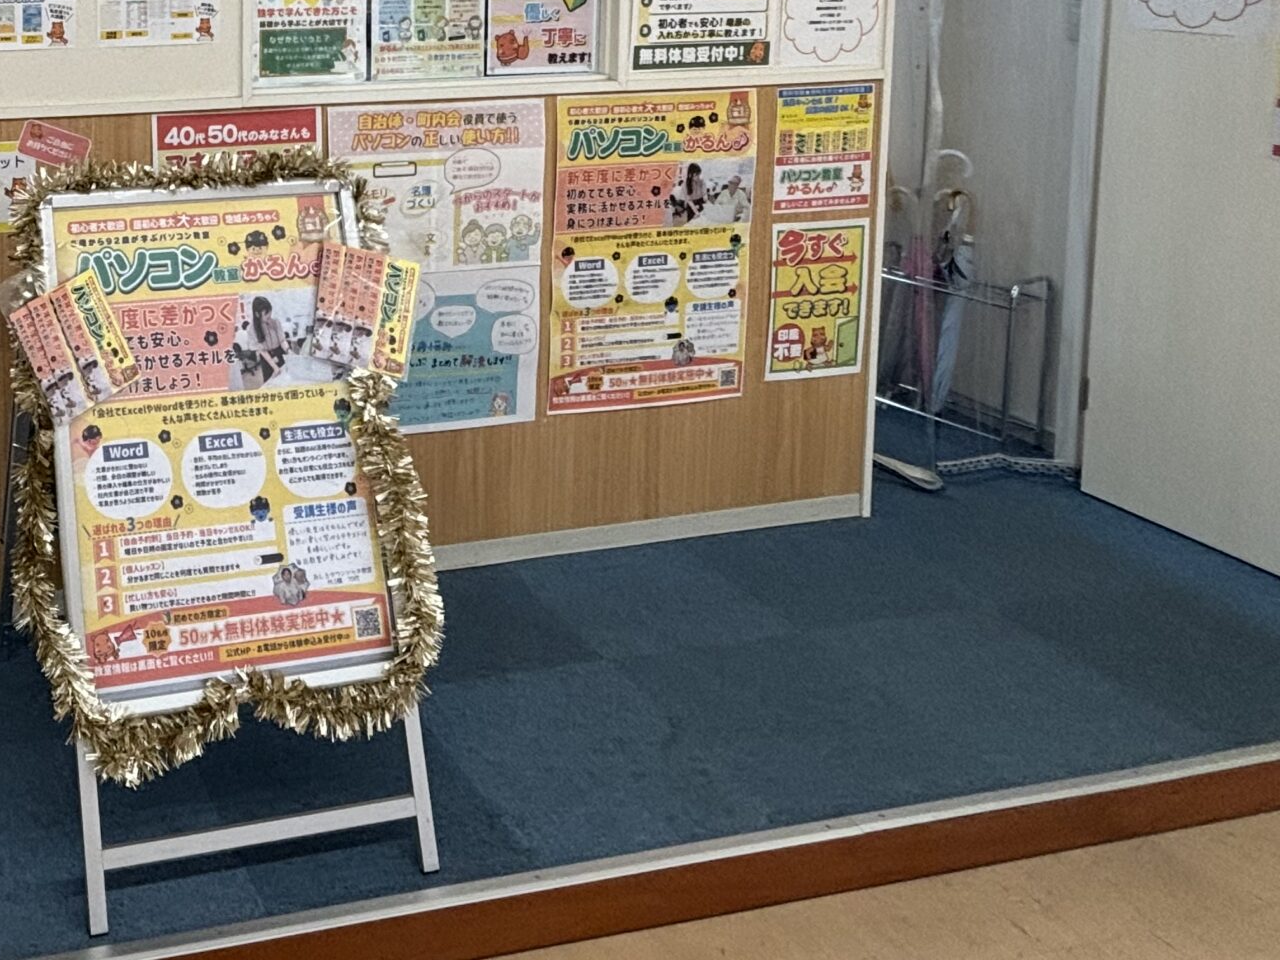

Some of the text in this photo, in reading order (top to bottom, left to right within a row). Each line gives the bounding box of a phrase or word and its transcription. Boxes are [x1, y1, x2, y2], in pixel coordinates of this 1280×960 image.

[524, 2, 561, 23] 優しく
[541, 26, 587, 47] 丁寧に
[639, 45, 745, 65] 無料体験受付中!
[163, 123, 311, 146] 40代50代のみなさんも
[567, 126, 669, 161] パソコン
[567, 166, 683, 186] 新年度に差がつく!
[780, 167, 843, 184] パソコン教室
[566, 199, 671, 215] 実務に活かせるスキルを
[69, 220, 126, 234] 初心者大歓迎
[566, 215, 646, 230] 身につけましょう!
[777, 228, 849, 266] 今すぐ
[77, 244, 218, 293] パソコン
[578, 261, 602, 270] Word
[642, 256, 665, 265] Excel
[790, 264, 850, 298] 入会
[782, 297, 851, 320] できます!
[205, 434, 239, 450] Excel
[284, 425, 343, 441] 生活にも役立つ
[109, 444, 144, 459] Word
[293, 500, 357, 520] 受講生様の声
[92, 516, 171, 535] 選ばれる3つの理由
[148, 639, 167, 652] 限定
